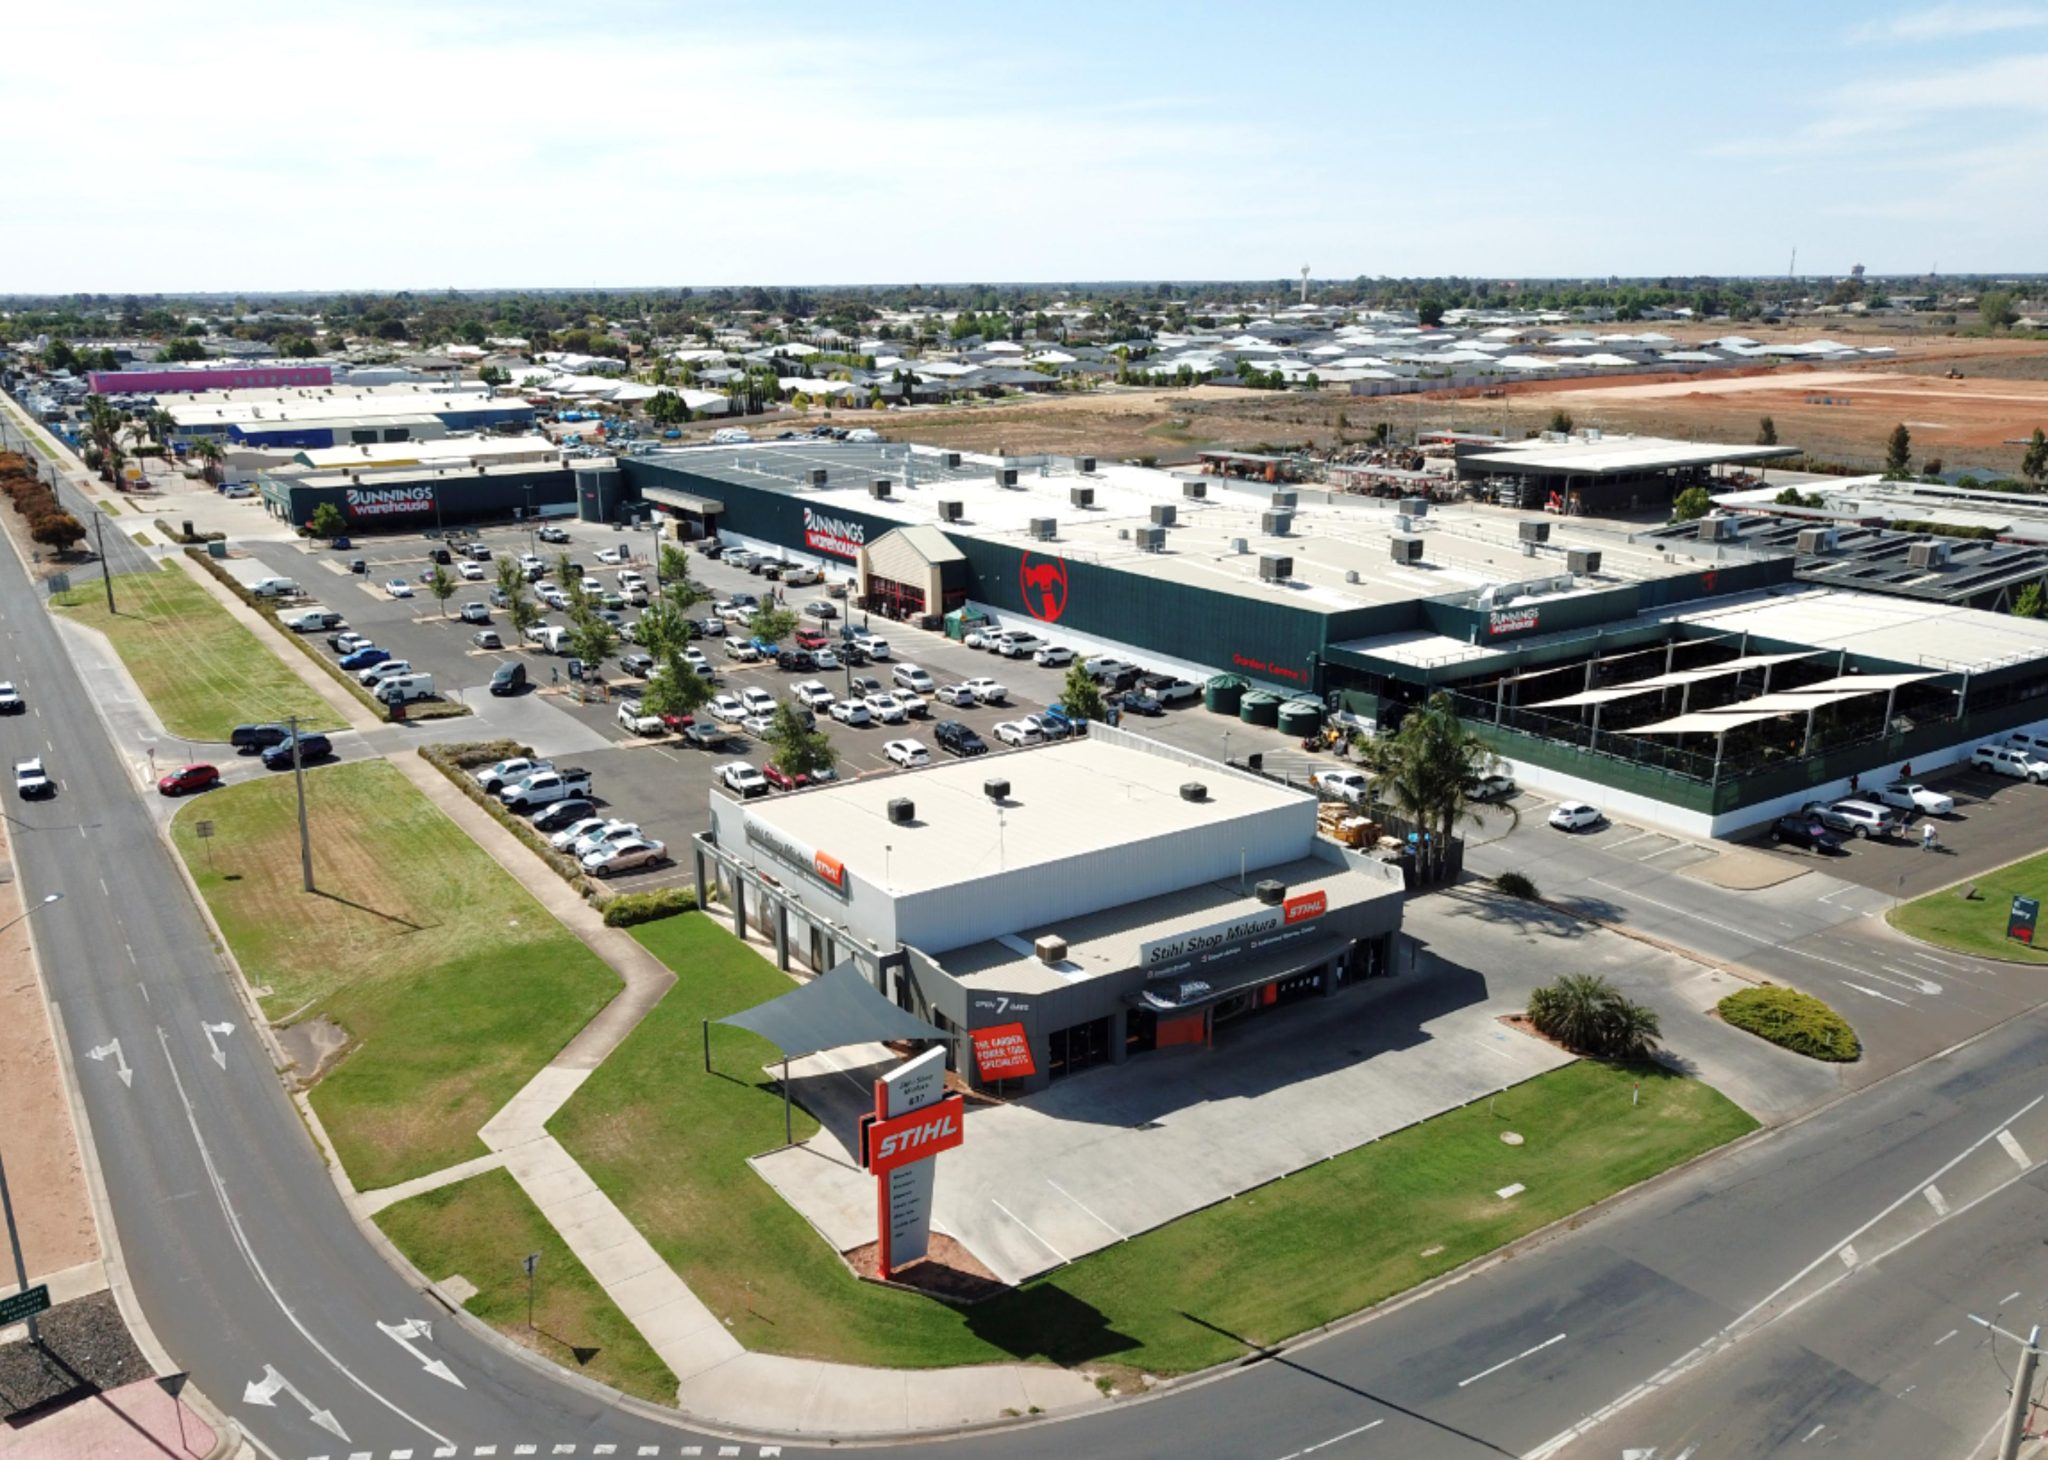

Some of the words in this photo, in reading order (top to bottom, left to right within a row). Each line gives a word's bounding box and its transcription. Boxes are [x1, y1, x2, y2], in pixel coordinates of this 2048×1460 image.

[346, 486, 434, 505] BUNNINGS
[355, 500, 430, 515] warehouse
[803, 507, 864, 544] BUNNINGS
[809, 533, 859, 557] warehous
[1150, 941, 1184, 963] Stihl
[1187, 933, 1222, 953] Shop
[1226, 918, 1277, 942] Mildura
[1288, 901, 1323, 919] STIHL
[996, 997, 1008, 1014] 7
[977, 1048, 1006, 1060] POWER
[981, 1054, 1029, 1070] SPECIALISTS
[877, 1115, 958, 1160] STIHL
